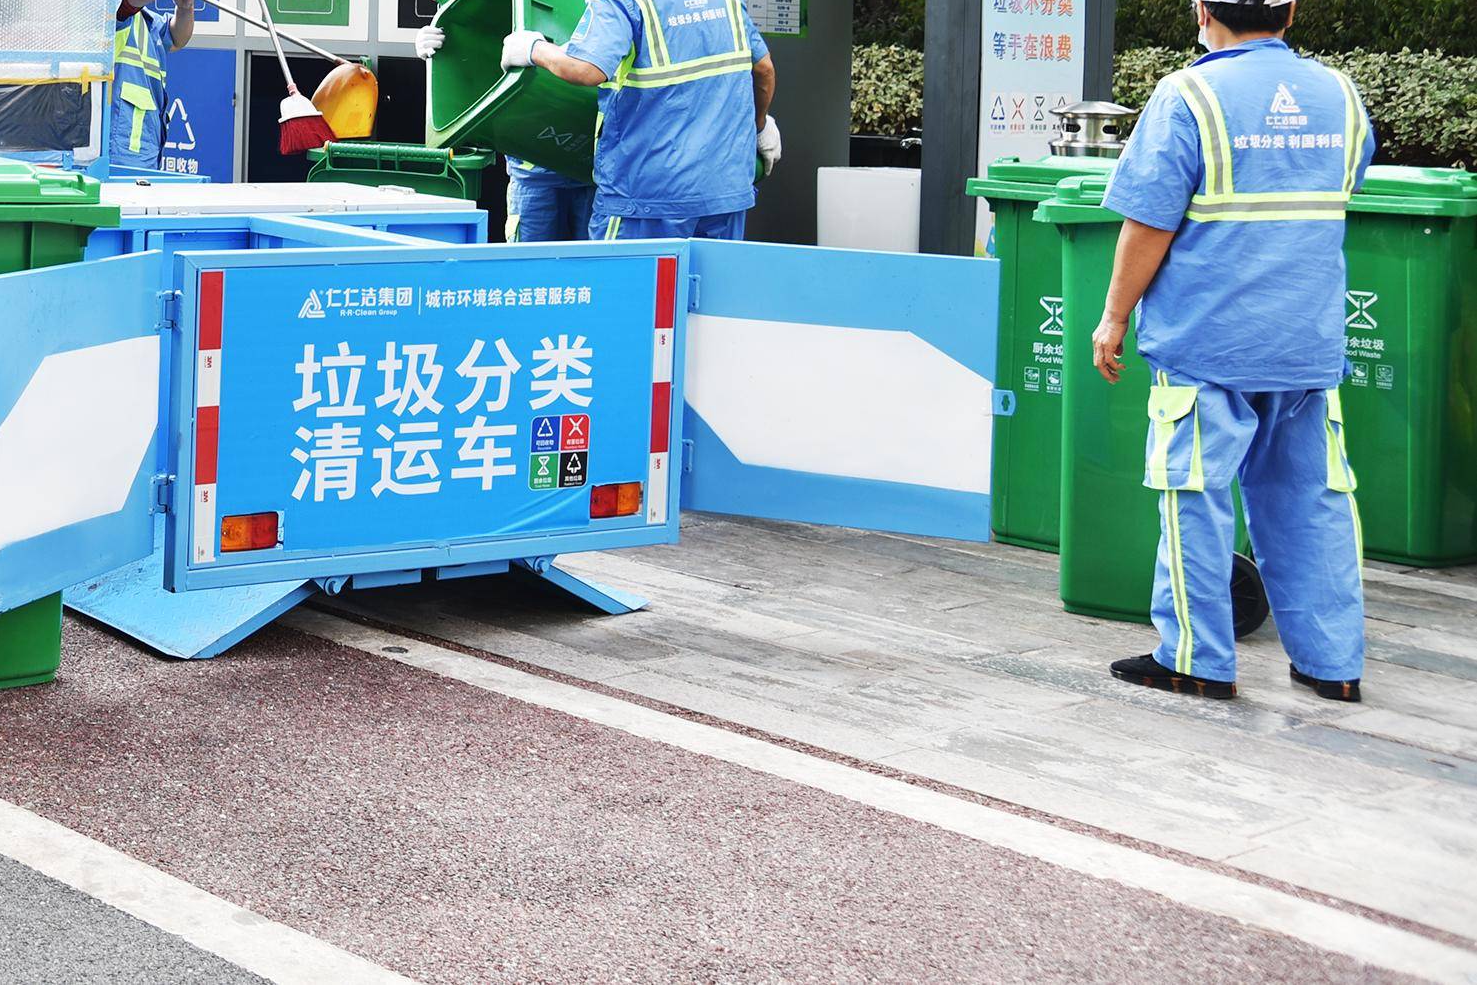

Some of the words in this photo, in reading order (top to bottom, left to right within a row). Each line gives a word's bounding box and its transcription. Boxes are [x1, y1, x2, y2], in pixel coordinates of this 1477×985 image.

[1233, 133, 1285, 149] 垃圾分类
[1288, 133, 1344, 149] 利国利民
[325, 286, 413, 308] 仁仁洁集团
[425, 286, 592, 309] 城市环境综合运营服务商
[378, 308, 398, 317] Group
[1035, 355, 1052, 364] Food
[1359, 350, 1382, 359] Waste
[292, 334, 594, 418] 垃圾分类
[290, 415, 518, 503] 清运车
